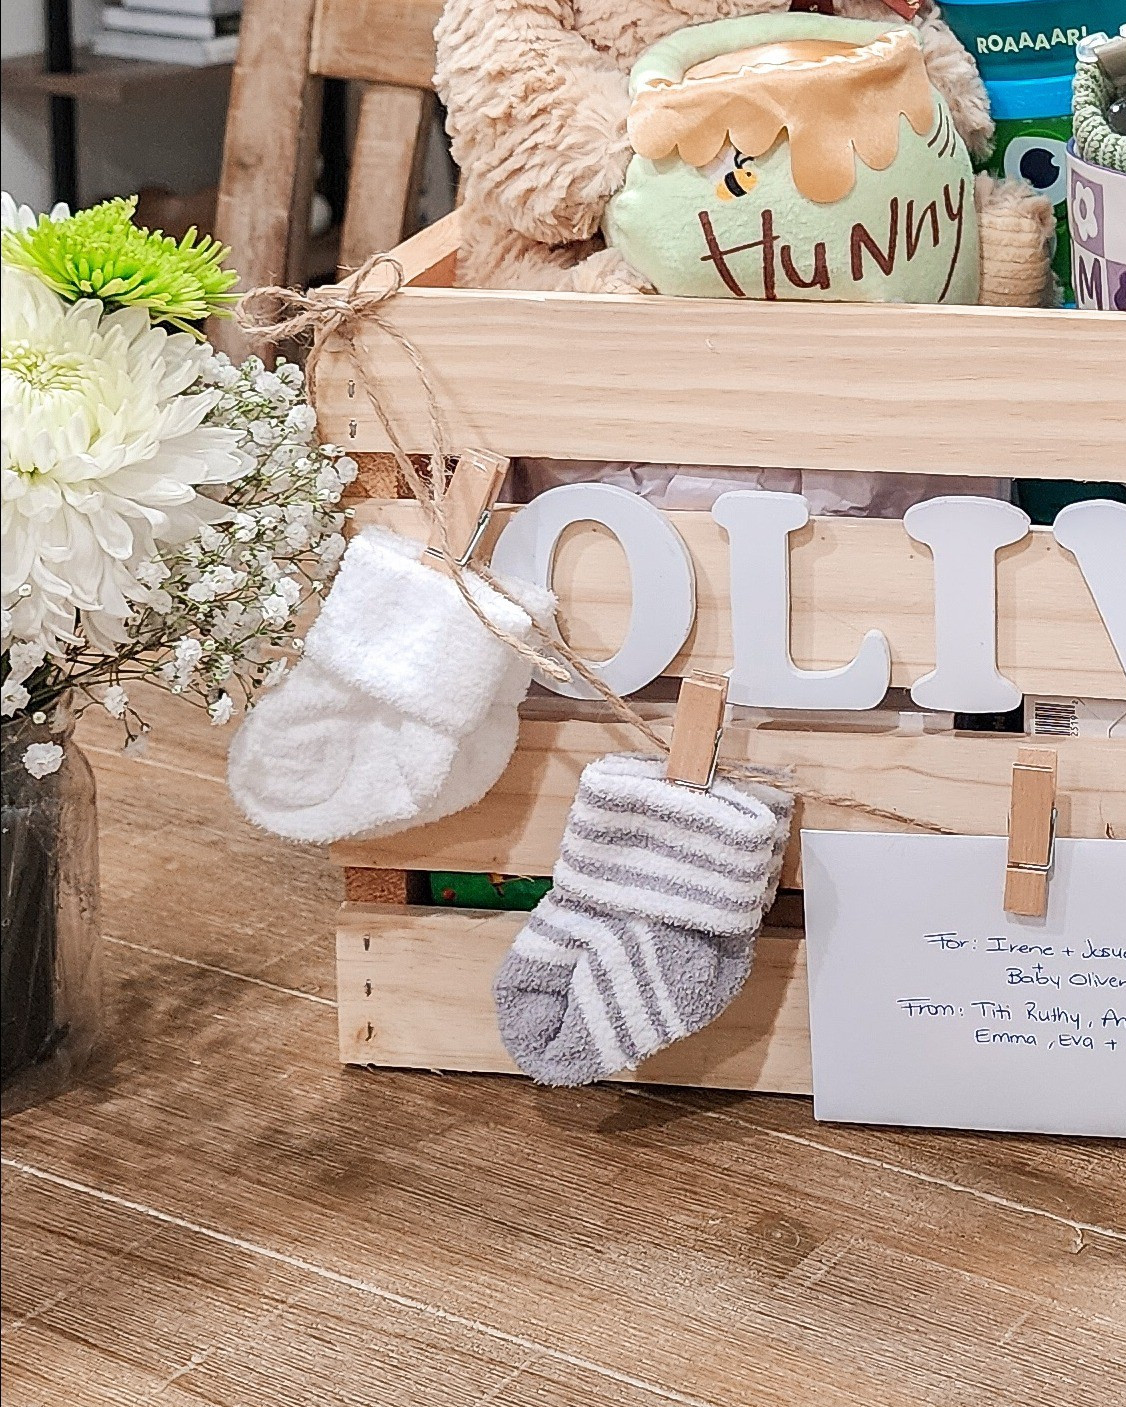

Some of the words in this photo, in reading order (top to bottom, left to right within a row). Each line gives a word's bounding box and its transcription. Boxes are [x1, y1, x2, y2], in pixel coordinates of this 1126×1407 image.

[923, 932, 977, 950] For:
[986, 937, 1055, 956] Irene
[1006, 968, 1061, 989] Baby
[897, 998, 965, 1017] From:
[971, 1002, 1012, 1021] Titi
